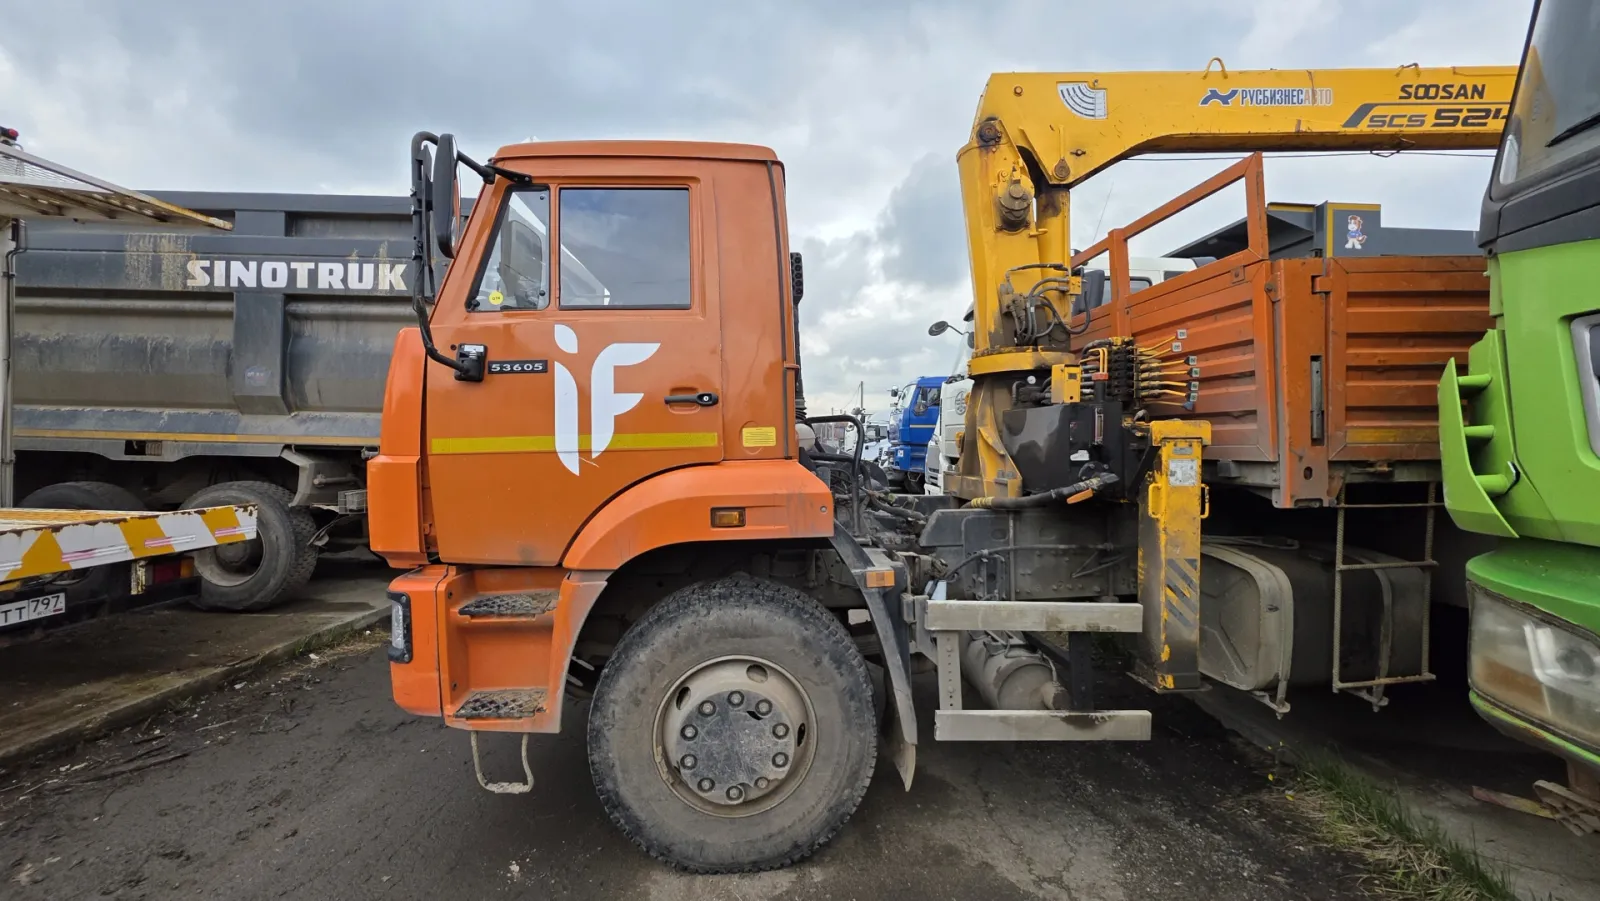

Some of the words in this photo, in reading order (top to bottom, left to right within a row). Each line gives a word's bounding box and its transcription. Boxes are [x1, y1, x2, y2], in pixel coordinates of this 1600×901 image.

[1240, 88, 1333, 106] РУСБИЗНЕСАВТО
[1398, 83, 1486, 101] SOOSAN
[1366, 114, 1428, 128] SCS
[186, 259, 408, 291] SINOTRUK
[491, 363, 544, 372] 53605
[30, 594, 61, 613] 797
